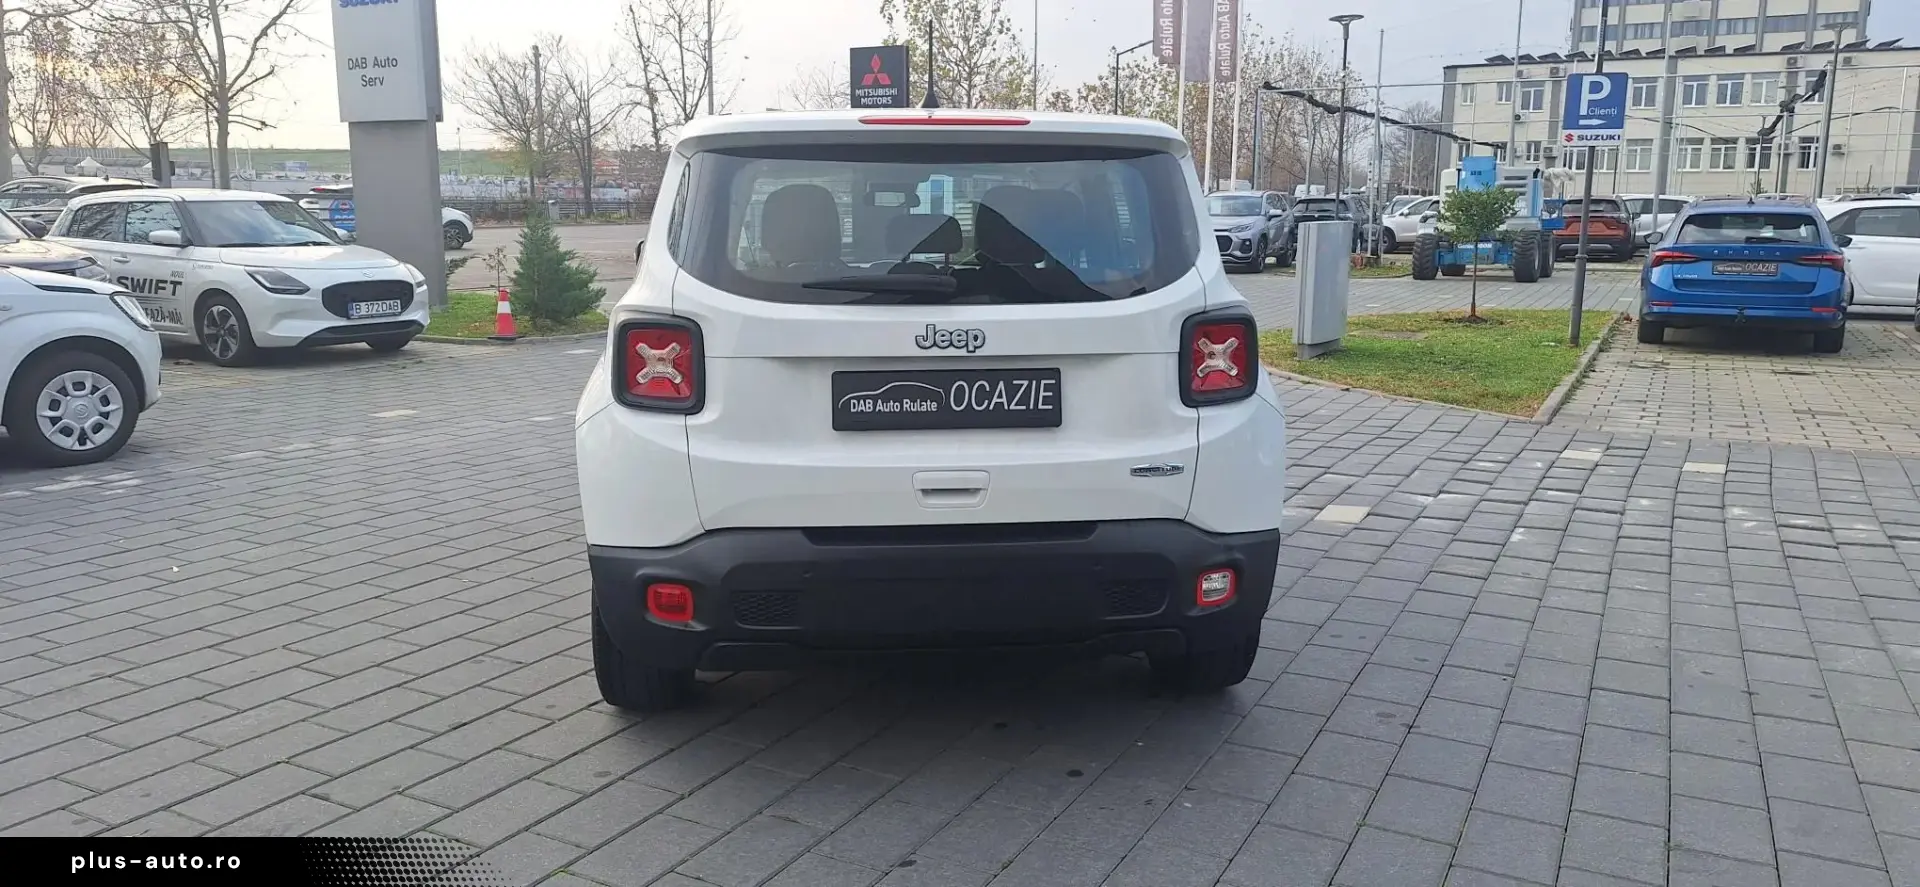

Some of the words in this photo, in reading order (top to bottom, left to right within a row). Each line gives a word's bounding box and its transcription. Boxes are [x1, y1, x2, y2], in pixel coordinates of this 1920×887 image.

[347, 57, 368, 70] DAB
[372, 56, 398, 68] Auto
[361, 74, 384, 87] Serv
[855, 88, 898, 97] MITSUBISHI
[1579, 75, 1611, 116] P
[860, 97, 892, 105] MOTORS
[1745, 263, 1778, 272] OCAZIE
[116, 275, 183, 297] SWIFT
[355, 303, 361, 314] B
[915, 324, 986, 353] Jeep
[950, 380, 1056, 411] OCAZIE
[850, 399, 873, 413] DAB
[875, 399, 900, 412] Auto
[903, 399, 938, 412] Rulate
